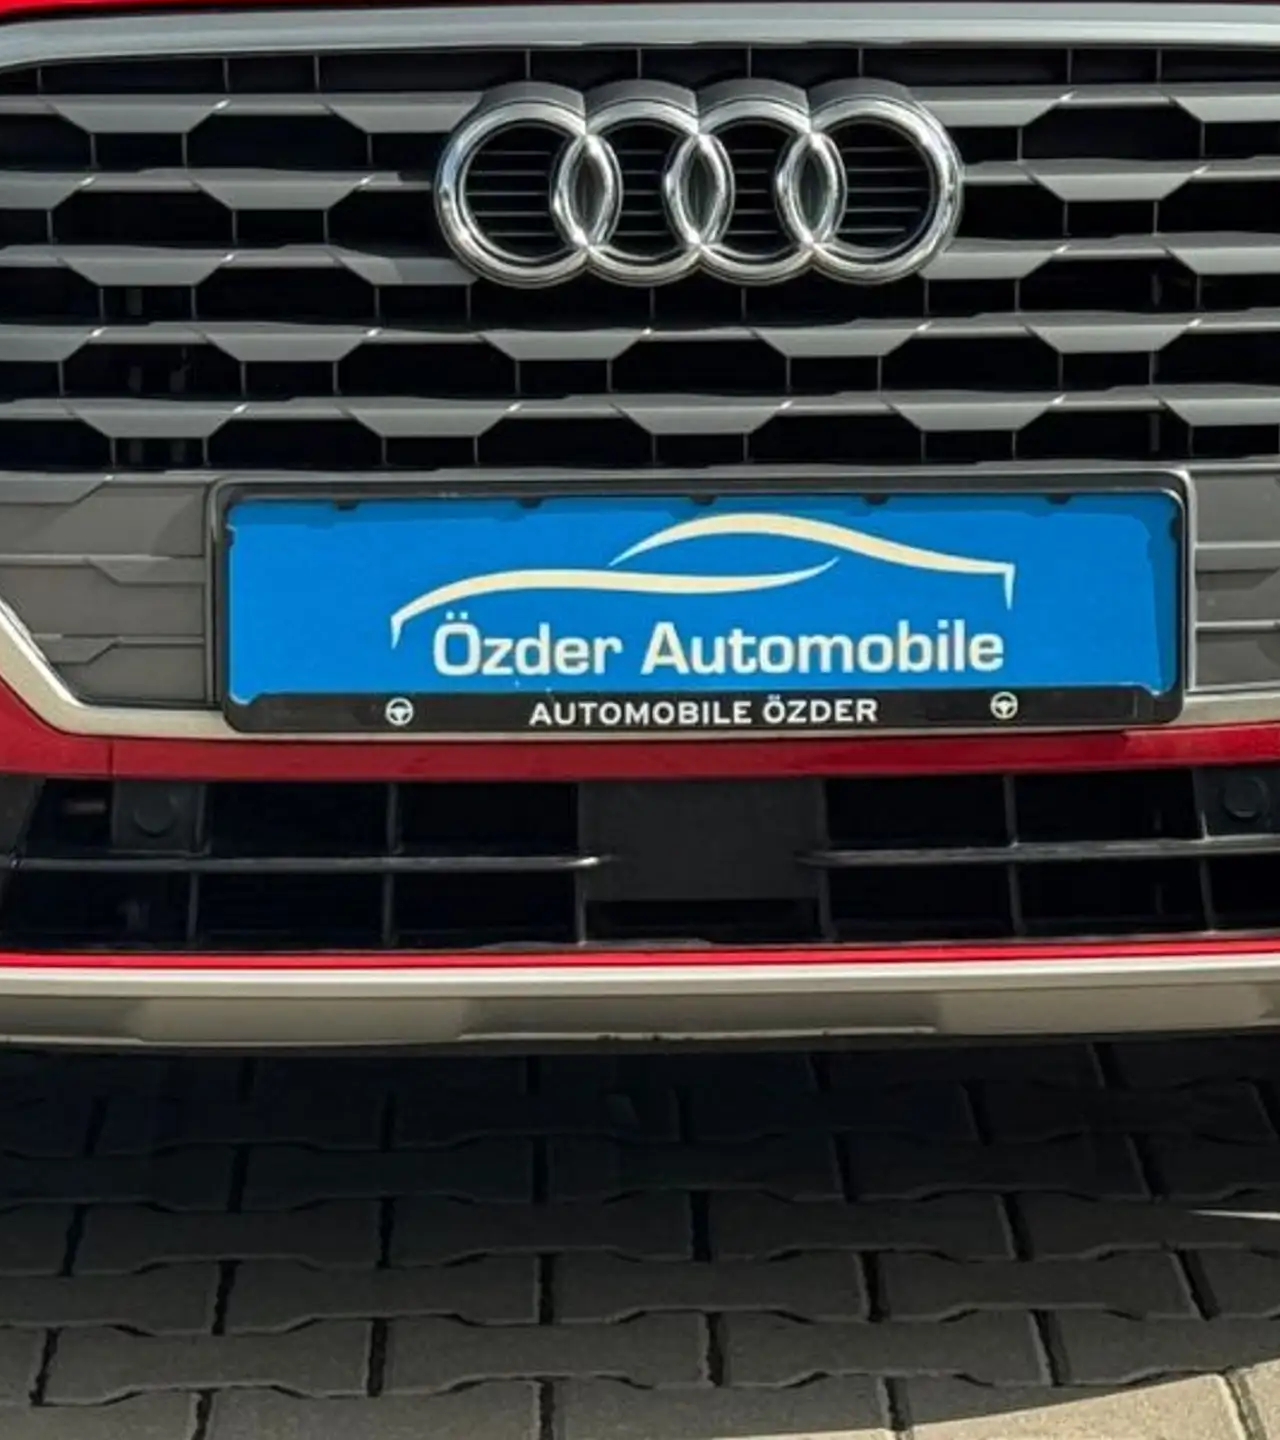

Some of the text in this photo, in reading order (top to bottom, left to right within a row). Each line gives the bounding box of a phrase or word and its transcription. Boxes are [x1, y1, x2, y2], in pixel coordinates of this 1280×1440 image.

[432, 611, 1004, 676] Özder Automobile
[528, 694, 879, 726] AUTOMOBILE ÖZDER
